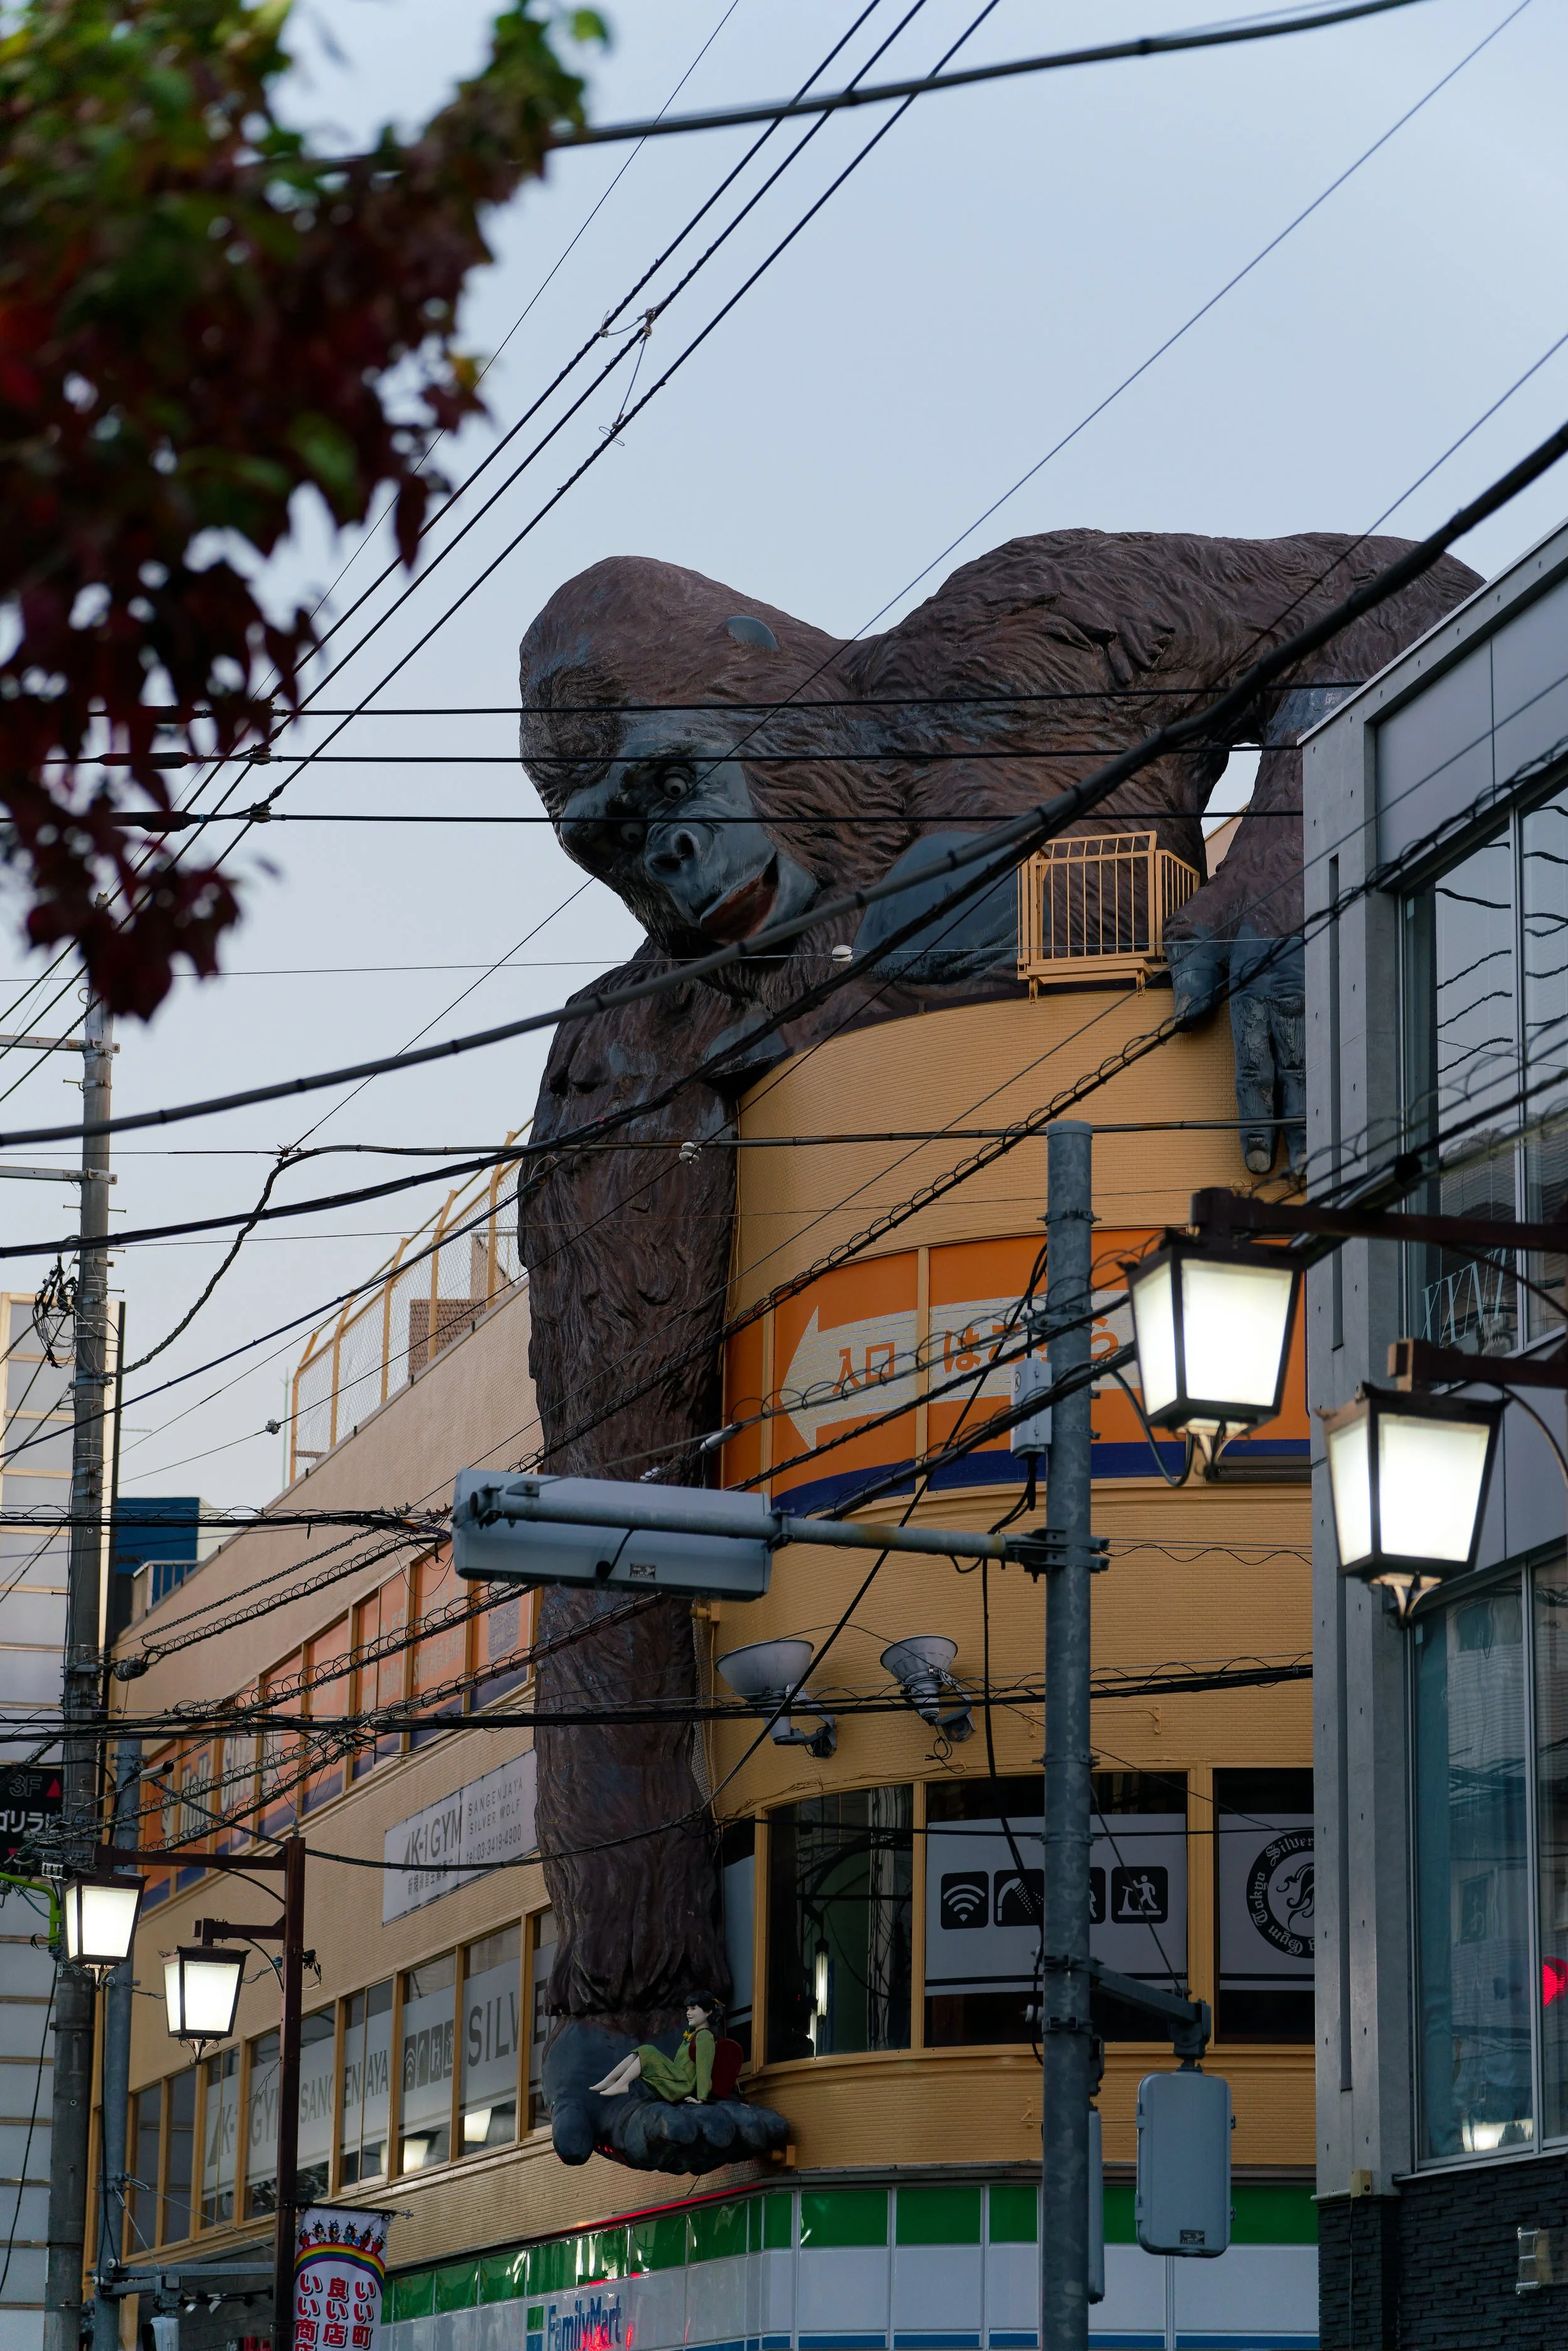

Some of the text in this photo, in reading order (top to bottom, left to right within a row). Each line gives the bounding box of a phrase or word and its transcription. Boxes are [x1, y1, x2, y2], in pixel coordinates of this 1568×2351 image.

[943, 1316, 1120, 1374] はこら
[9, 1775, 42, 1797] 3F
[469, 1777, 522, 1817] SANGENJAYA
[469, 1799, 520, 1835] SILVER WOLF
[468, 1978, 552, 2067] SILVE
[322, 2277, 349, 2347] 良い店
[352, 2281, 375, 2349] いい町
[548, 2295, 622, 2351] FamilyMart
